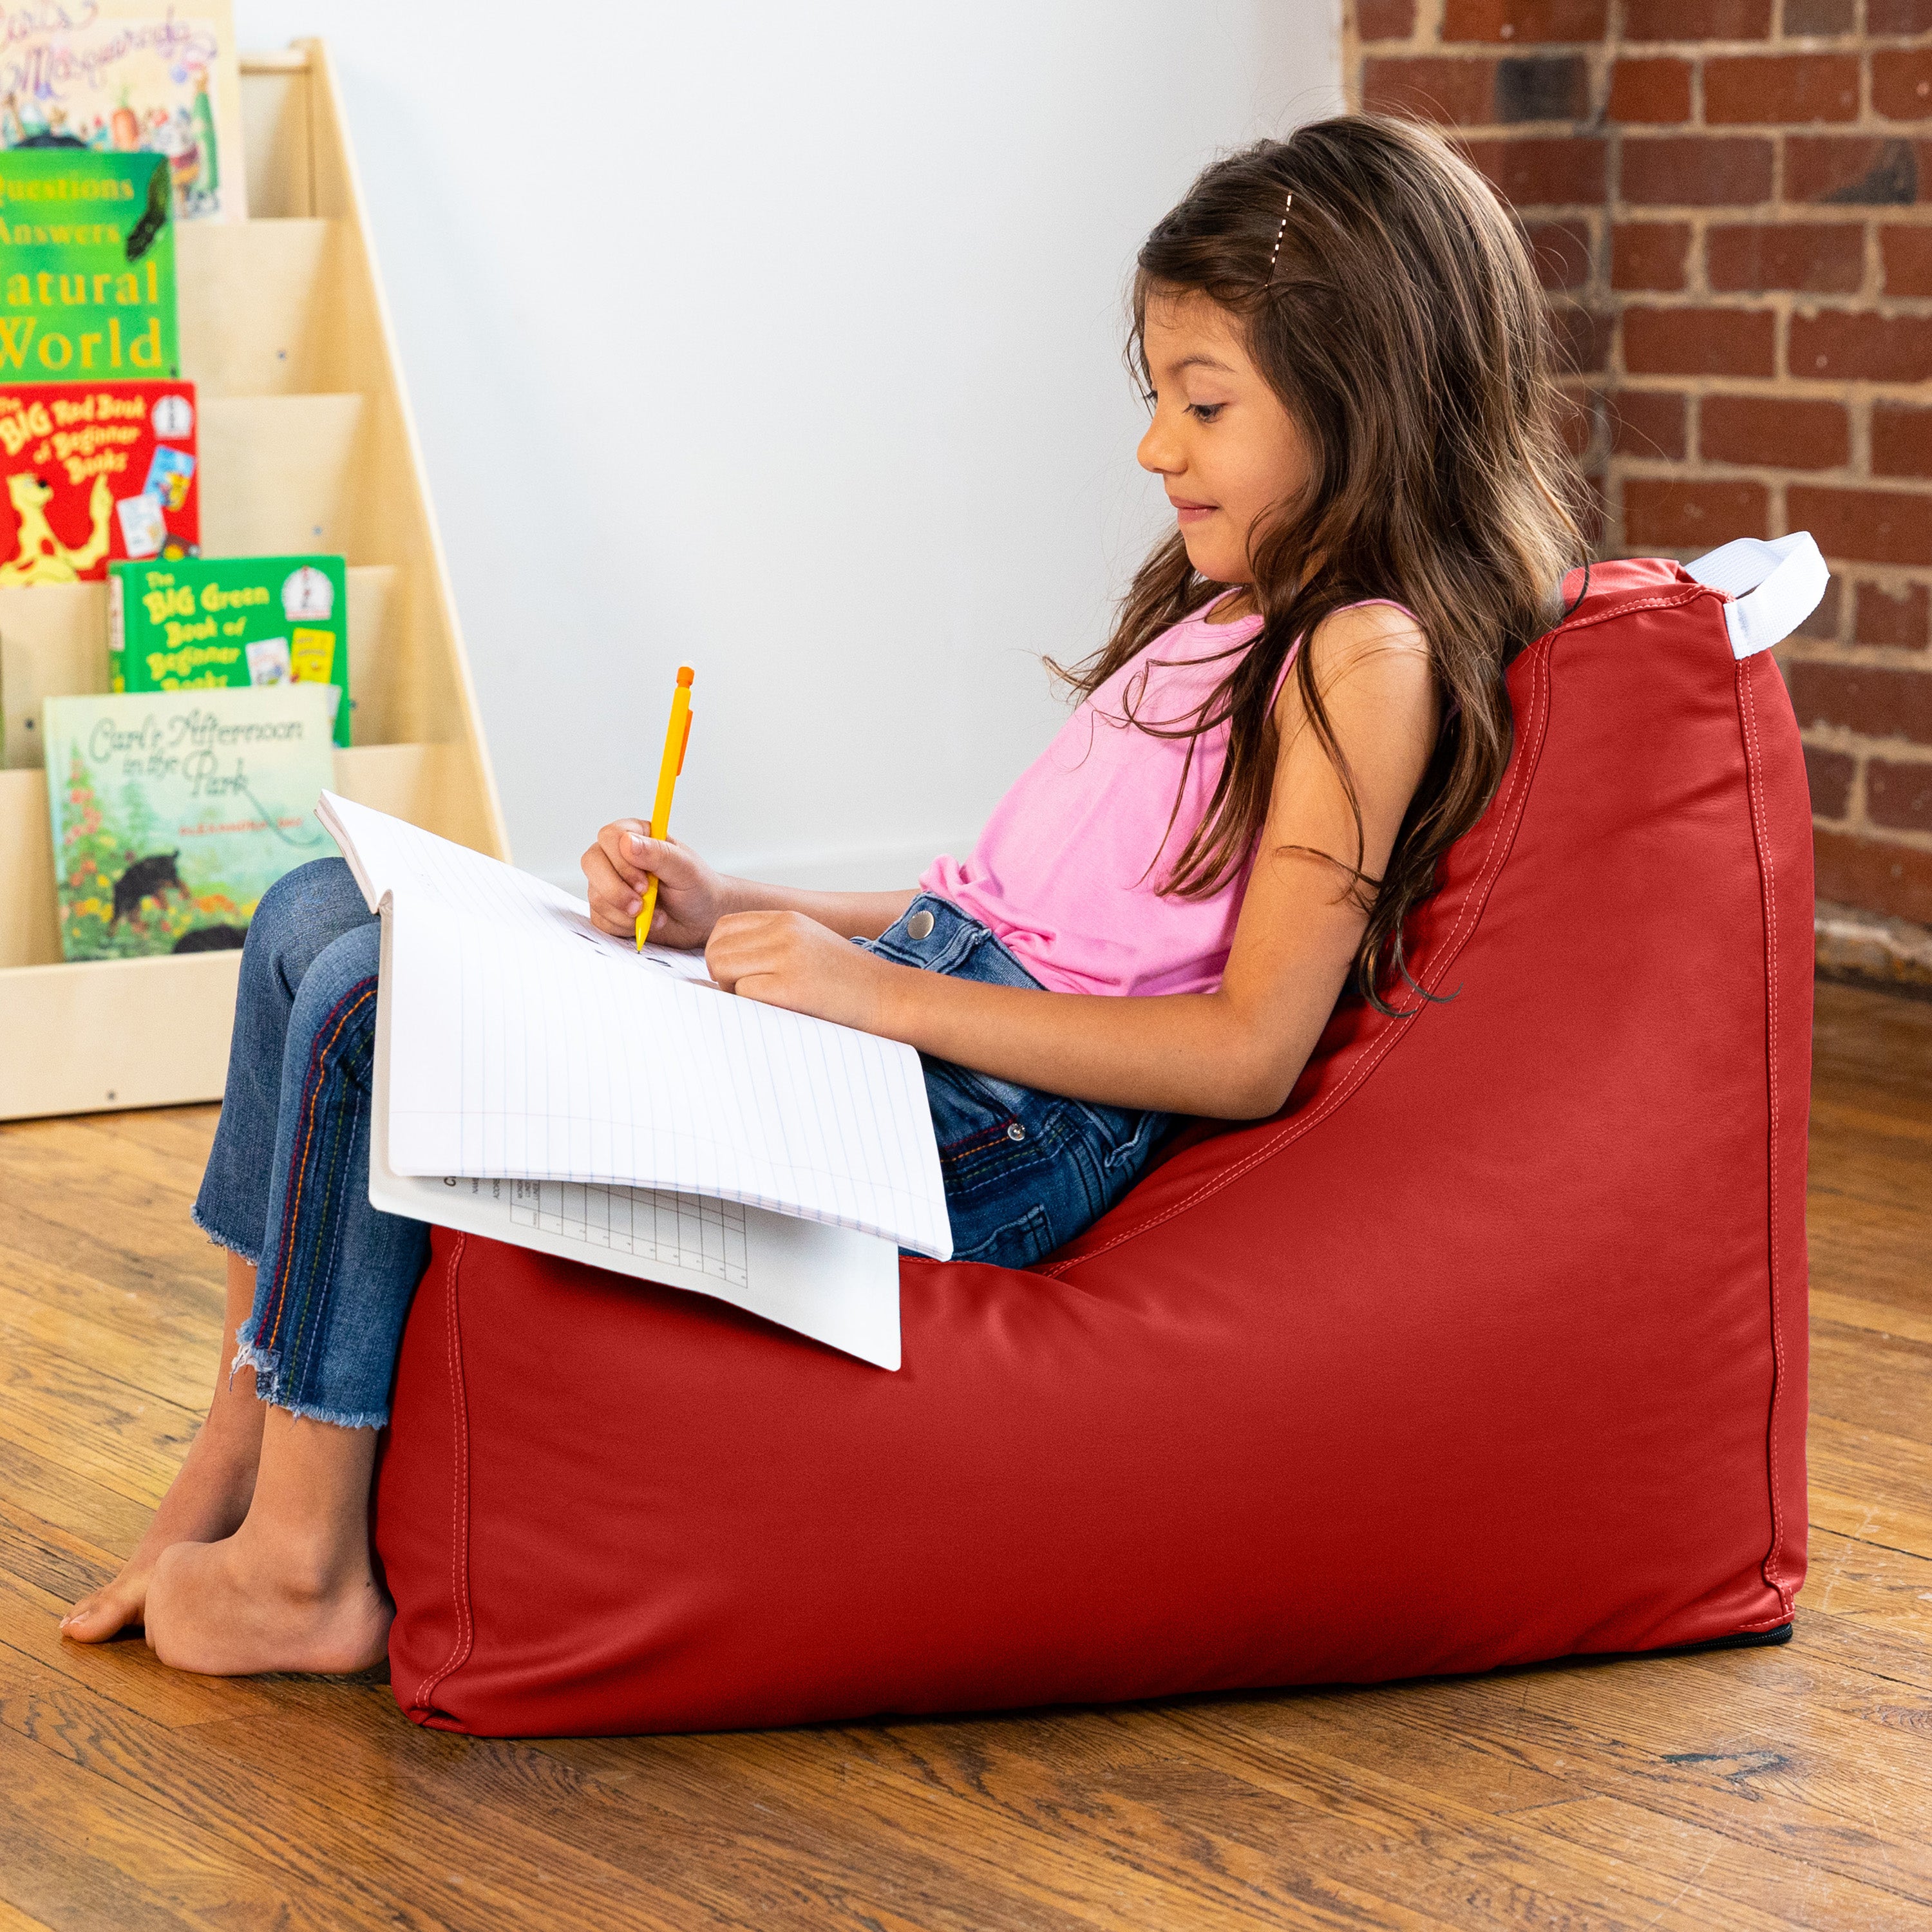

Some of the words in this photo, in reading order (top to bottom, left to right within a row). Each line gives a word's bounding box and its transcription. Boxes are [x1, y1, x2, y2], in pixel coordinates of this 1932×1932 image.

[0, 173, 135, 207] uestions
[6, 260, 160, 307] atural
[0, 401, 54, 457] BIG
[50, 393, 95, 426] Red
[97, 393, 147, 421] Book
[146, 571, 175, 589] The
[142, 584, 196, 625] BIG
[200, 582, 270, 612] Green
[164, 615, 218, 649] Book
